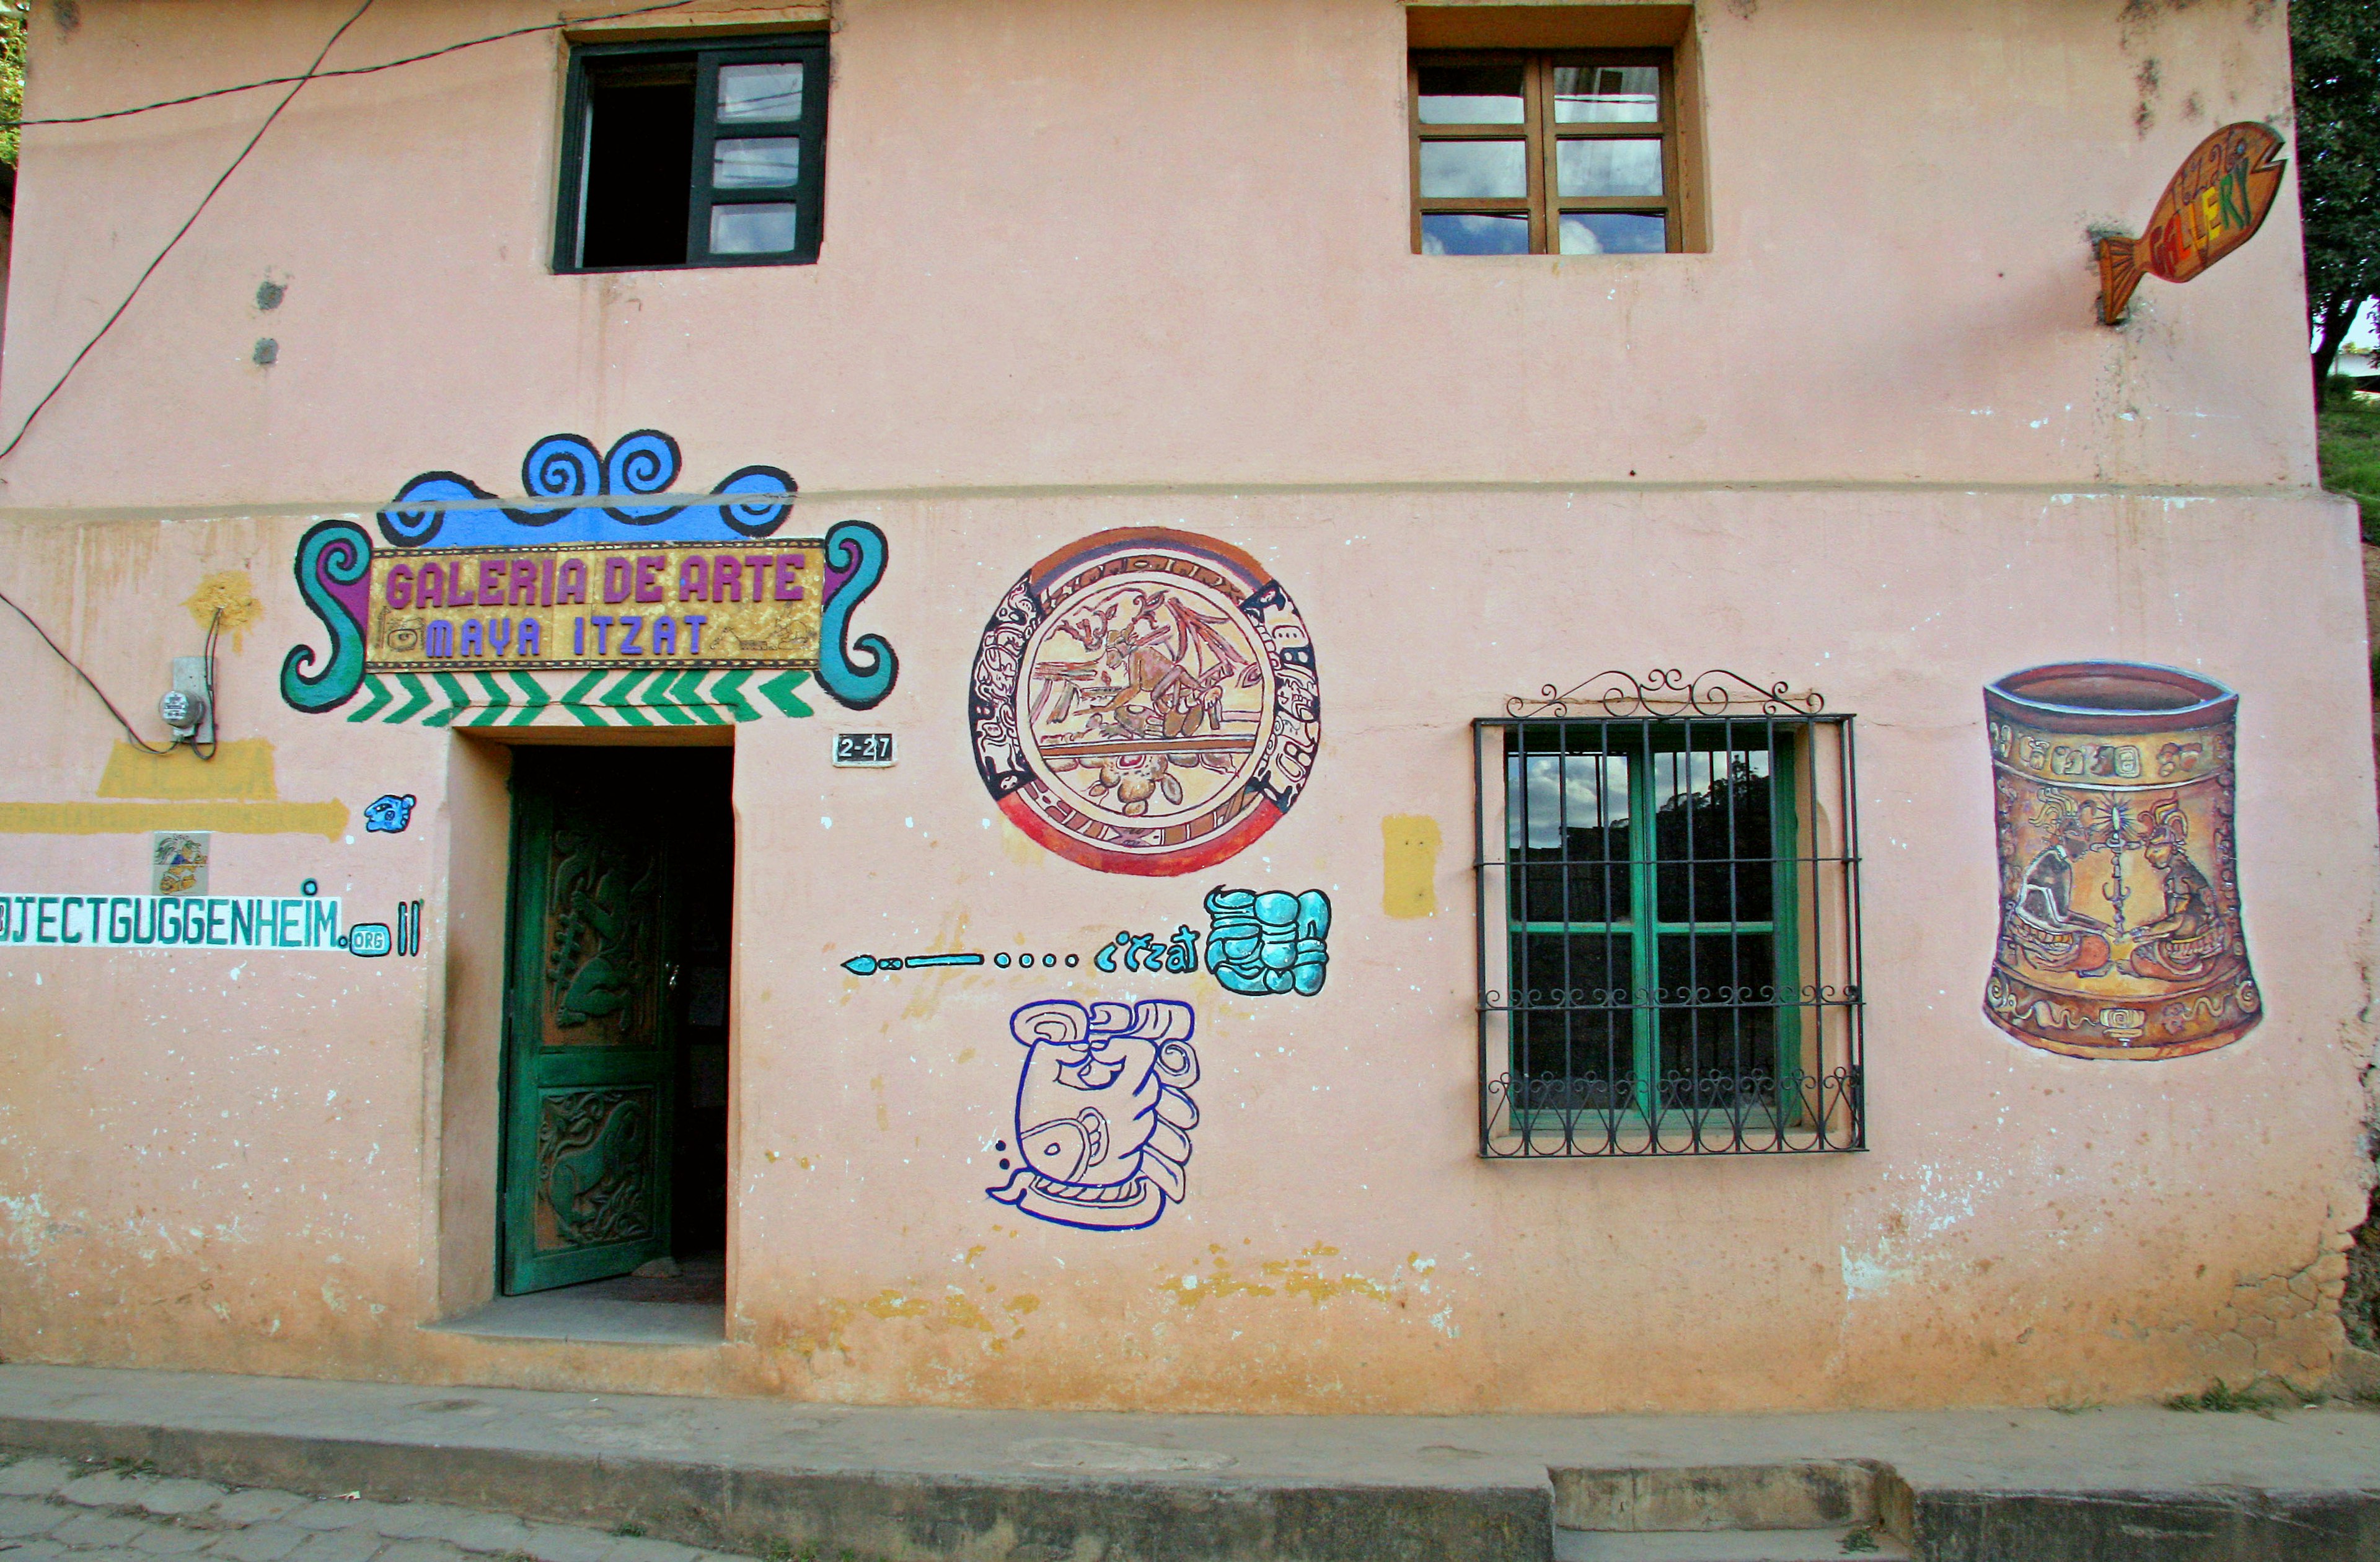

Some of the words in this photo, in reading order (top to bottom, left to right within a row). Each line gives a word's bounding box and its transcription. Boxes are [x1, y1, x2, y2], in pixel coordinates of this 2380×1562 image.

[386, 558, 586, 609] GALERIA
[603, 555, 666, 604] DE
[679, 554, 806, 603] ARTE
[425, 617, 540, 658] MAYA
[574, 615, 707, 655] ITZAT
[839, 738, 890, 757] 2-27
